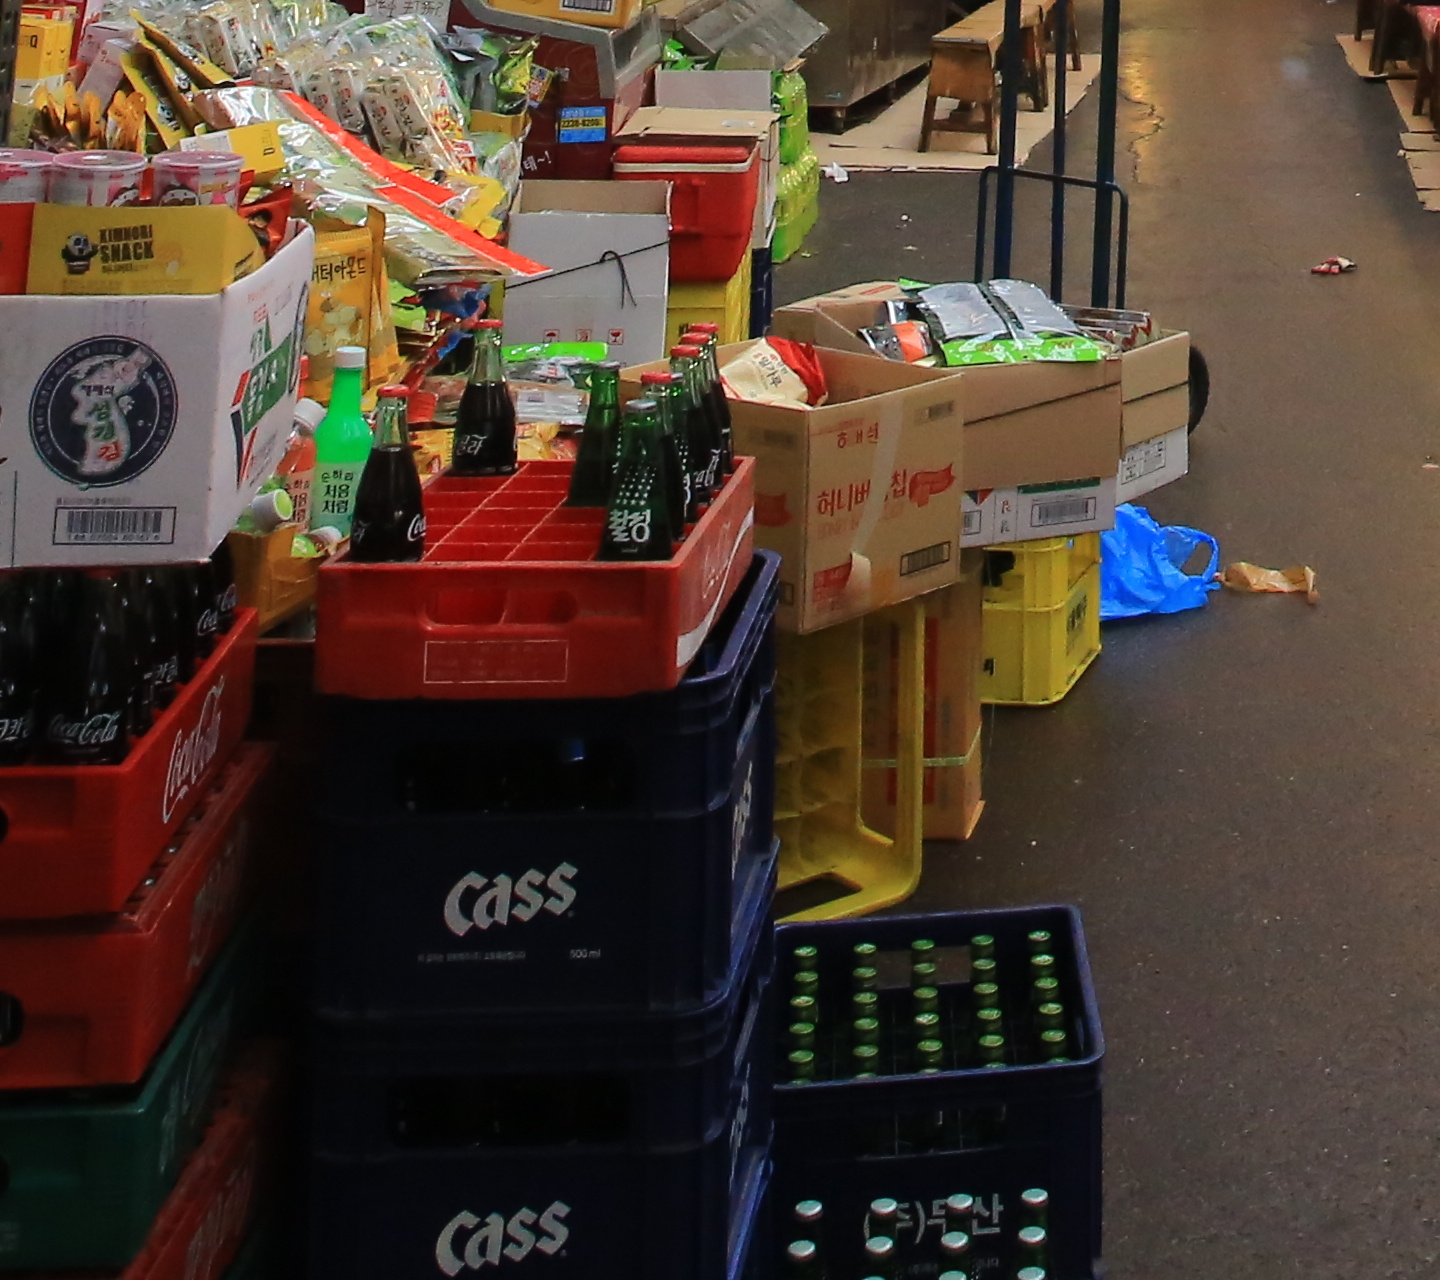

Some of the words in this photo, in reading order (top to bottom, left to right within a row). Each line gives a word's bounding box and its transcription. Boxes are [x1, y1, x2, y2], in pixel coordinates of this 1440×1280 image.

[98, 224, 154, 240] KIMNORI
[98, 242, 155, 265] SNACK
[322, 484, 350, 500] 처음
[816, 470, 909, 520] 허니버칩
[322, 500, 349, 515] 처럼
[607, 509, 652, 544] 칠성
